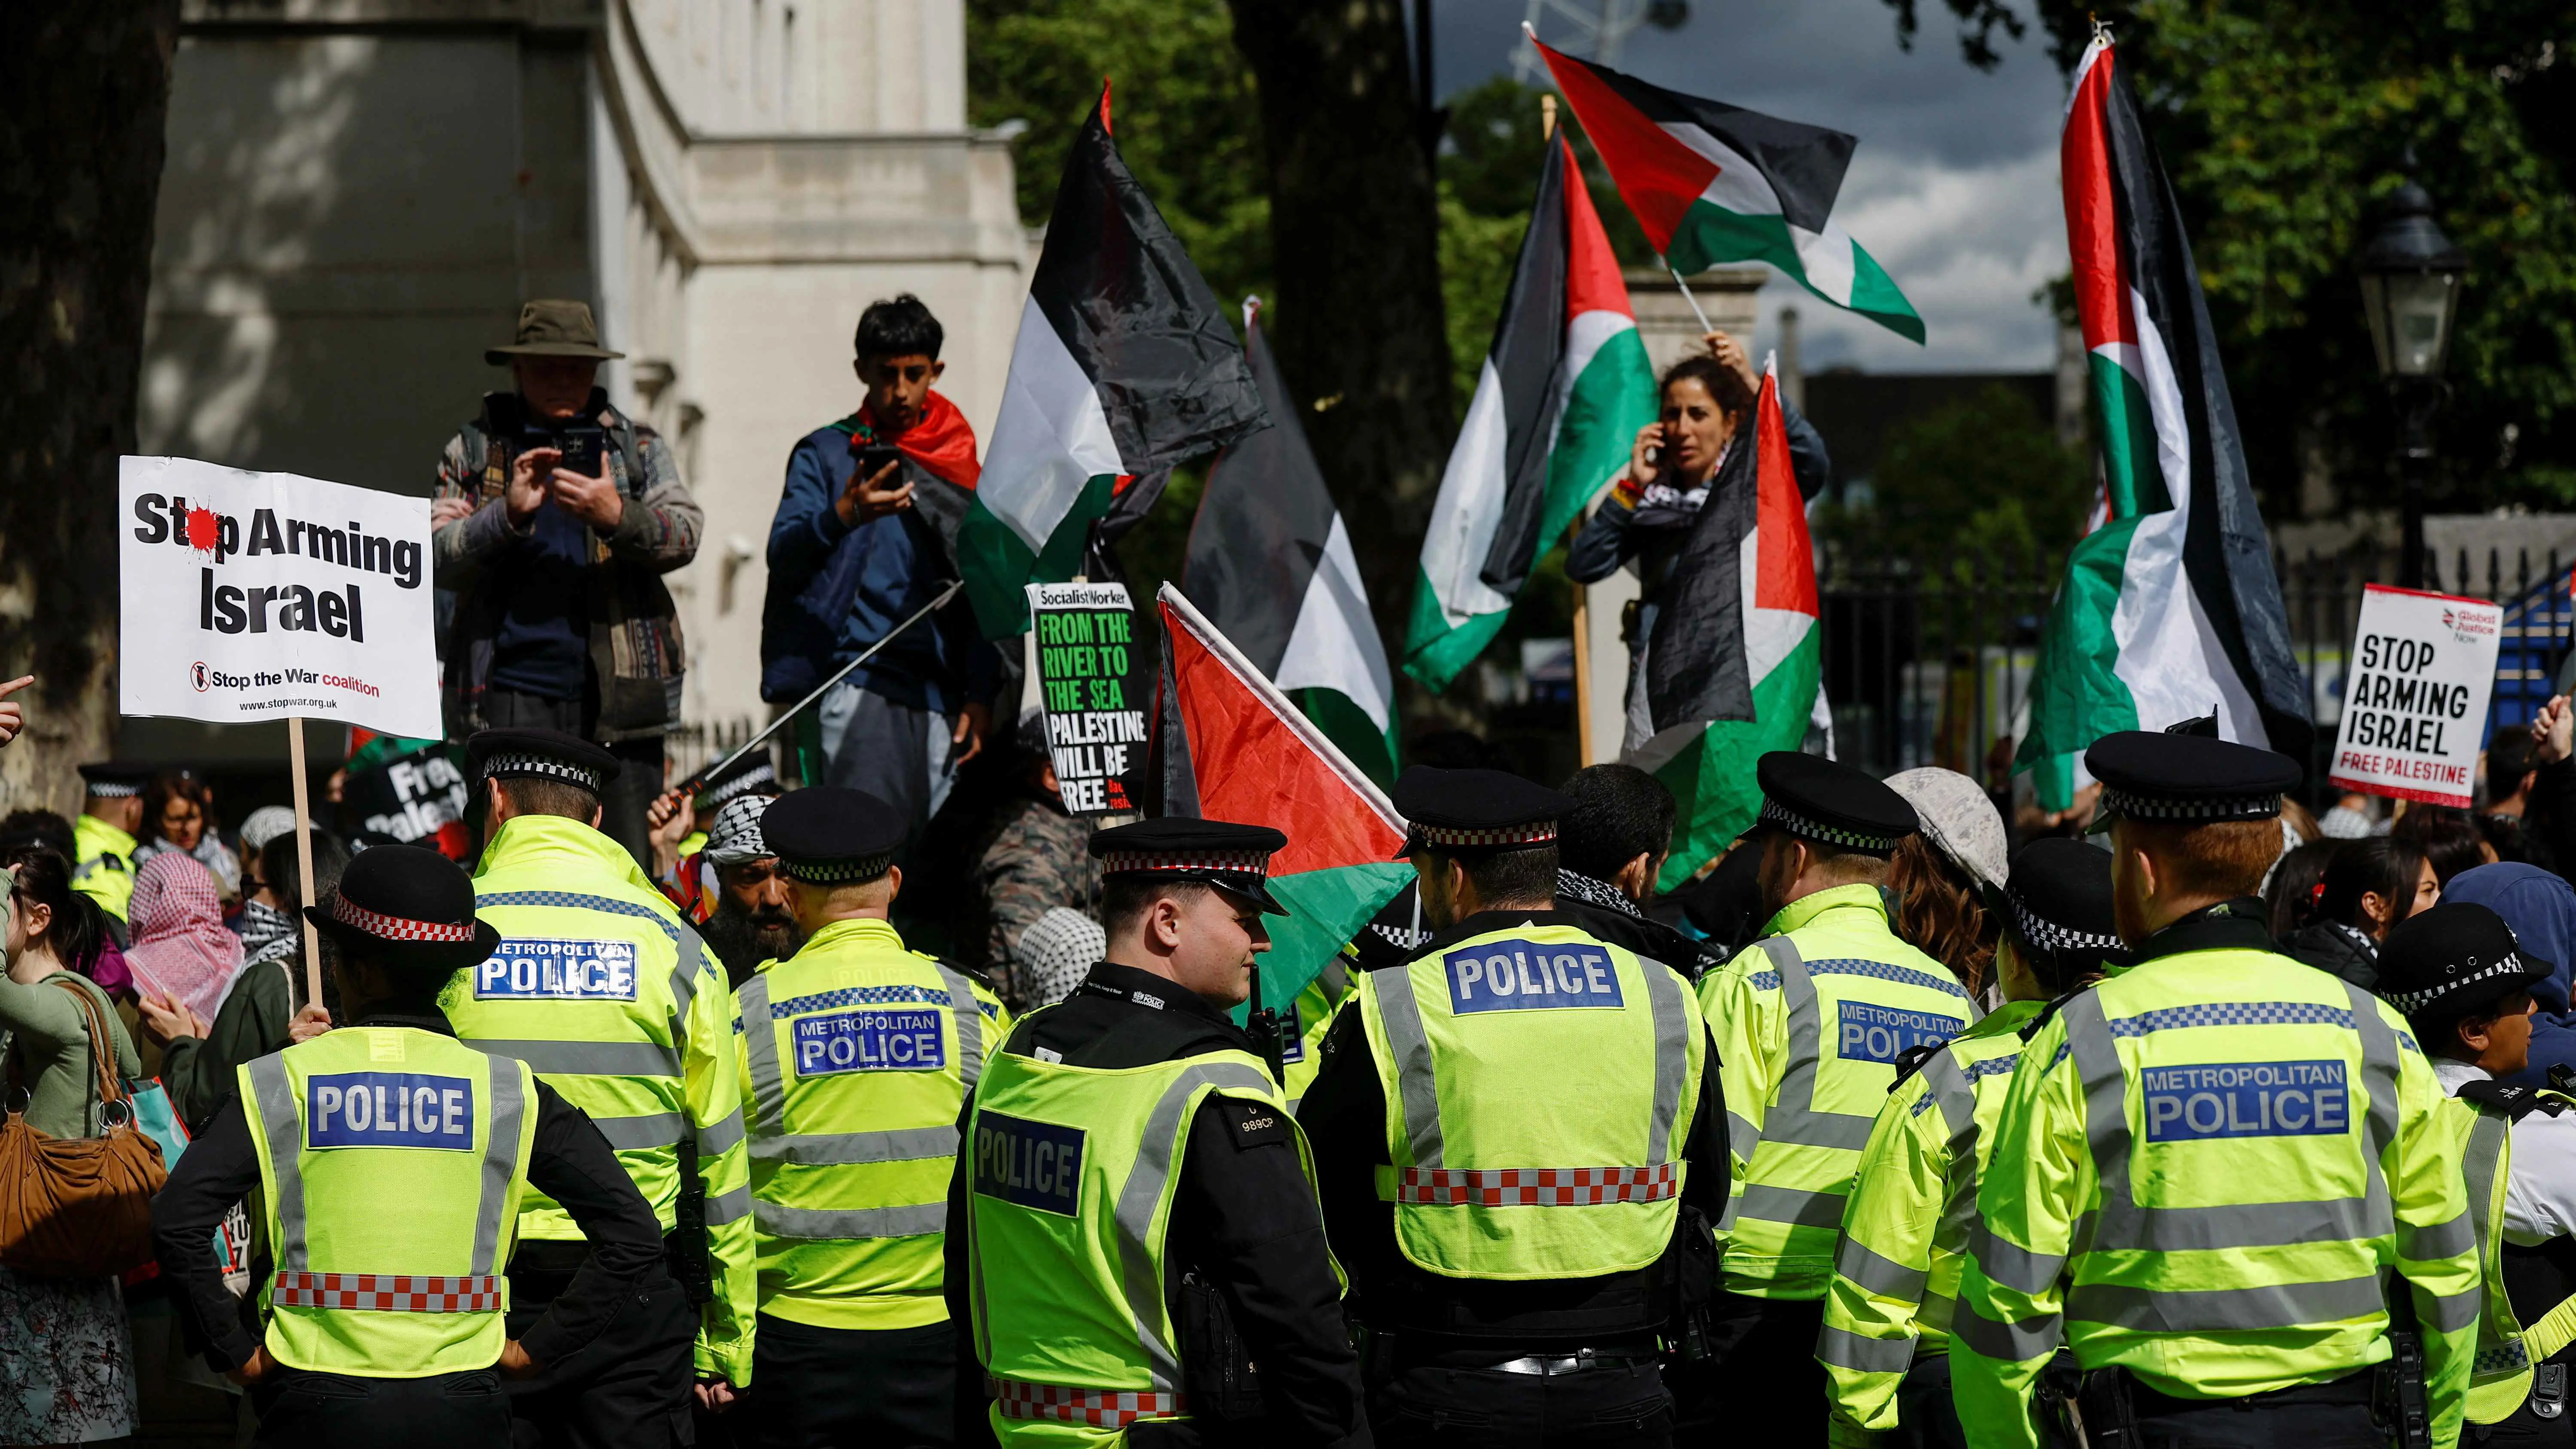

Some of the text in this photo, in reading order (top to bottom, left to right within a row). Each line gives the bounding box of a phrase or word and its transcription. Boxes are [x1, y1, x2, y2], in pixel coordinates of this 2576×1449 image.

[134, 493, 421, 589] Stp Arming
[200, 568, 364, 643] Israel
[2458, 610, 2495, 624] Global
[1039, 613, 1132, 644] FROM THE
[2454, 632, 2477, 644] Now
[2455, 622, 2494, 635] Justice
[1043, 645, 1128, 677] RIVER TO
[2363, 635, 2434, 674] STOP
[213, 669, 380, 698] Stop the War coalition
[1045, 679, 1124, 711] THE SEA
[2354, 673, 2468, 719] ARMING
[240, 698, 337, 711] www.stopwar.org.uk
[1050, 711, 1147, 745] PALESTINE
[2347, 711, 2448, 756] ISRAEL
[1054, 744, 1130, 778] WILL BE
[2340, 751, 2467, 785] FREE PALESTINE
[482, 958, 633, 993] POLICE
[1455, 952, 1611, 999] POLICE
[1143, 997, 1164, 1008] POLICE
[1841, 1004, 1965, 1033] METROPOLITAN
[800, 1015, 935, 1036] METROPOLITAN
[1842, 1023, 1953, 1059] POL
[802, 1034, 938, 1068] POLICE
[2146, 1065, 2343, 1092] METROPOLITAN
[2503, 1087, 2523, 1099] 2104
[317, 1085, 464, 1134] POLICE
[1242, 1118, 1273, 1132] 989CP
[2149, 1089, 2345, 1136] POLICE
[979, 1127, 1073, 1198] POLICE
